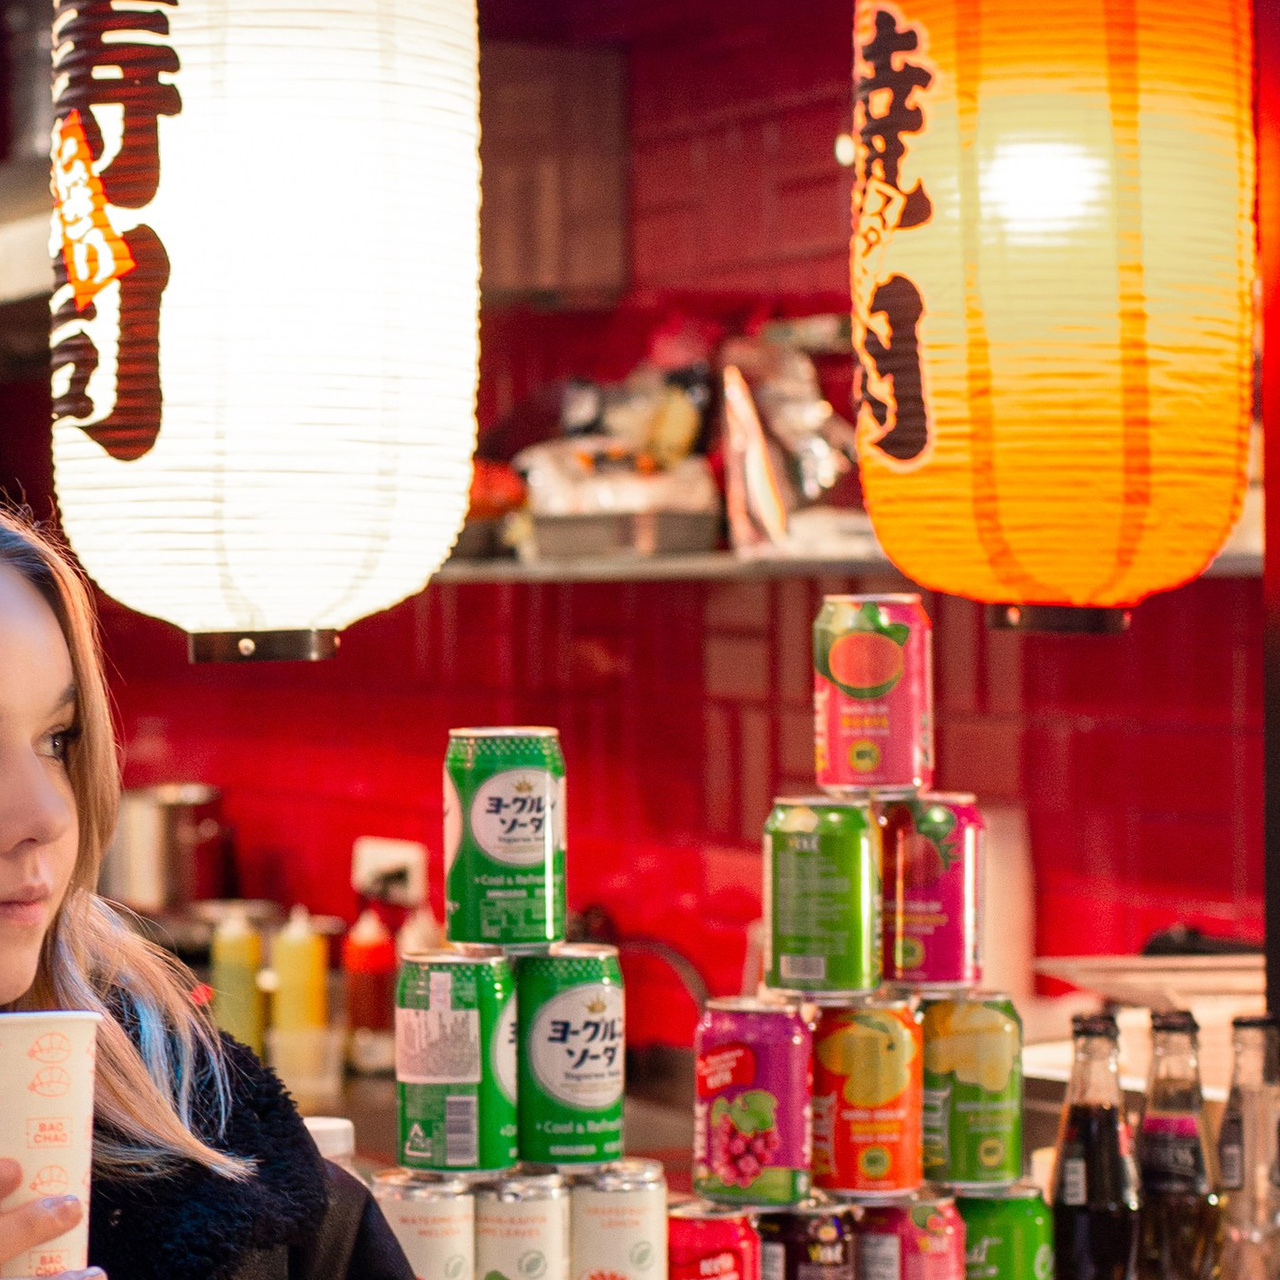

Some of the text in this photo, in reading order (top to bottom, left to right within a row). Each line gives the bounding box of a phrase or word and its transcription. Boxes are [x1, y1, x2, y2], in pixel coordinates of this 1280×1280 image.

[486, 796, 556, 814] ヨーグル
[548, 1017, 622, 1043] ヨーグル
